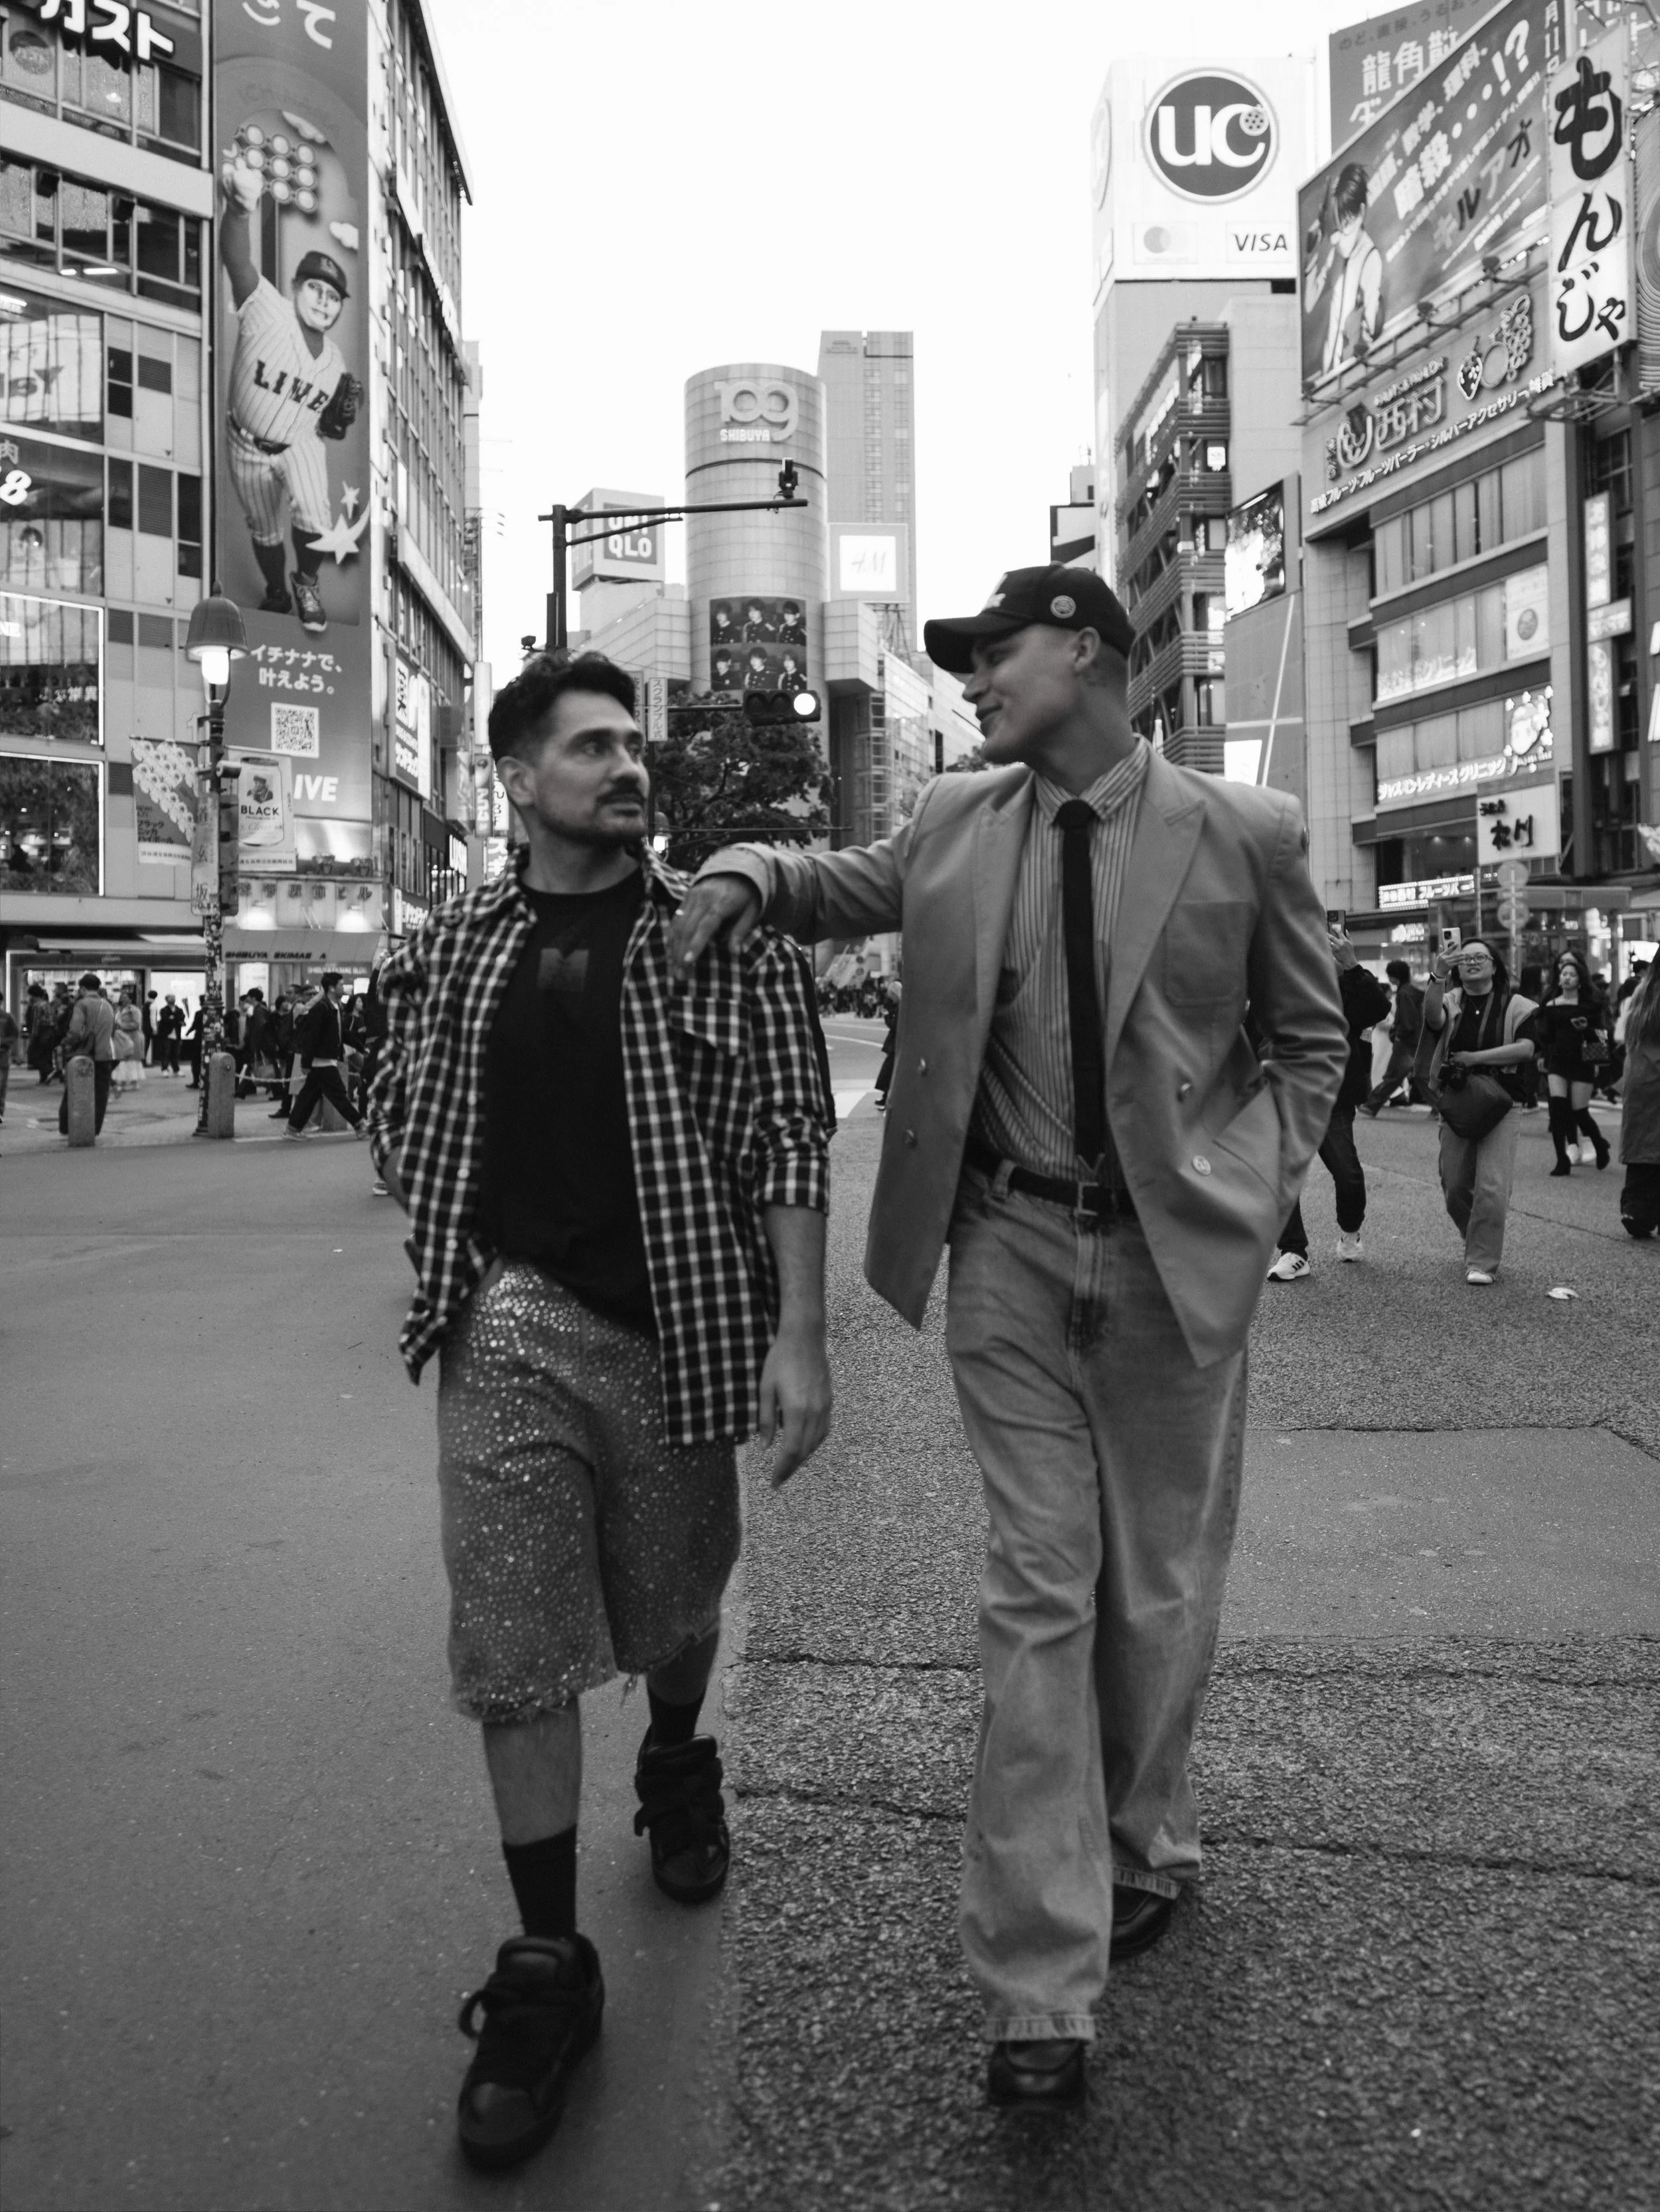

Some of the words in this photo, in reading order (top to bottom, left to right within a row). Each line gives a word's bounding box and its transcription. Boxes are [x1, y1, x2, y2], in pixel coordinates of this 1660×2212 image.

[1554, 56, 1626, 342] もんじゃ
[1230, 232, 1288, 252] VISA
[254, 359, 329, 414] LIVE
[714, 380, 799, 441] 109
[720, 428, 770, 442] SHIBUYA
[608, 534, 653, 558] QLO
[250, 644, 343, 672] イチナナで、
[259, 667, 335, 695] 叶えよう。
[240, 805, 280, 816] BLACK
